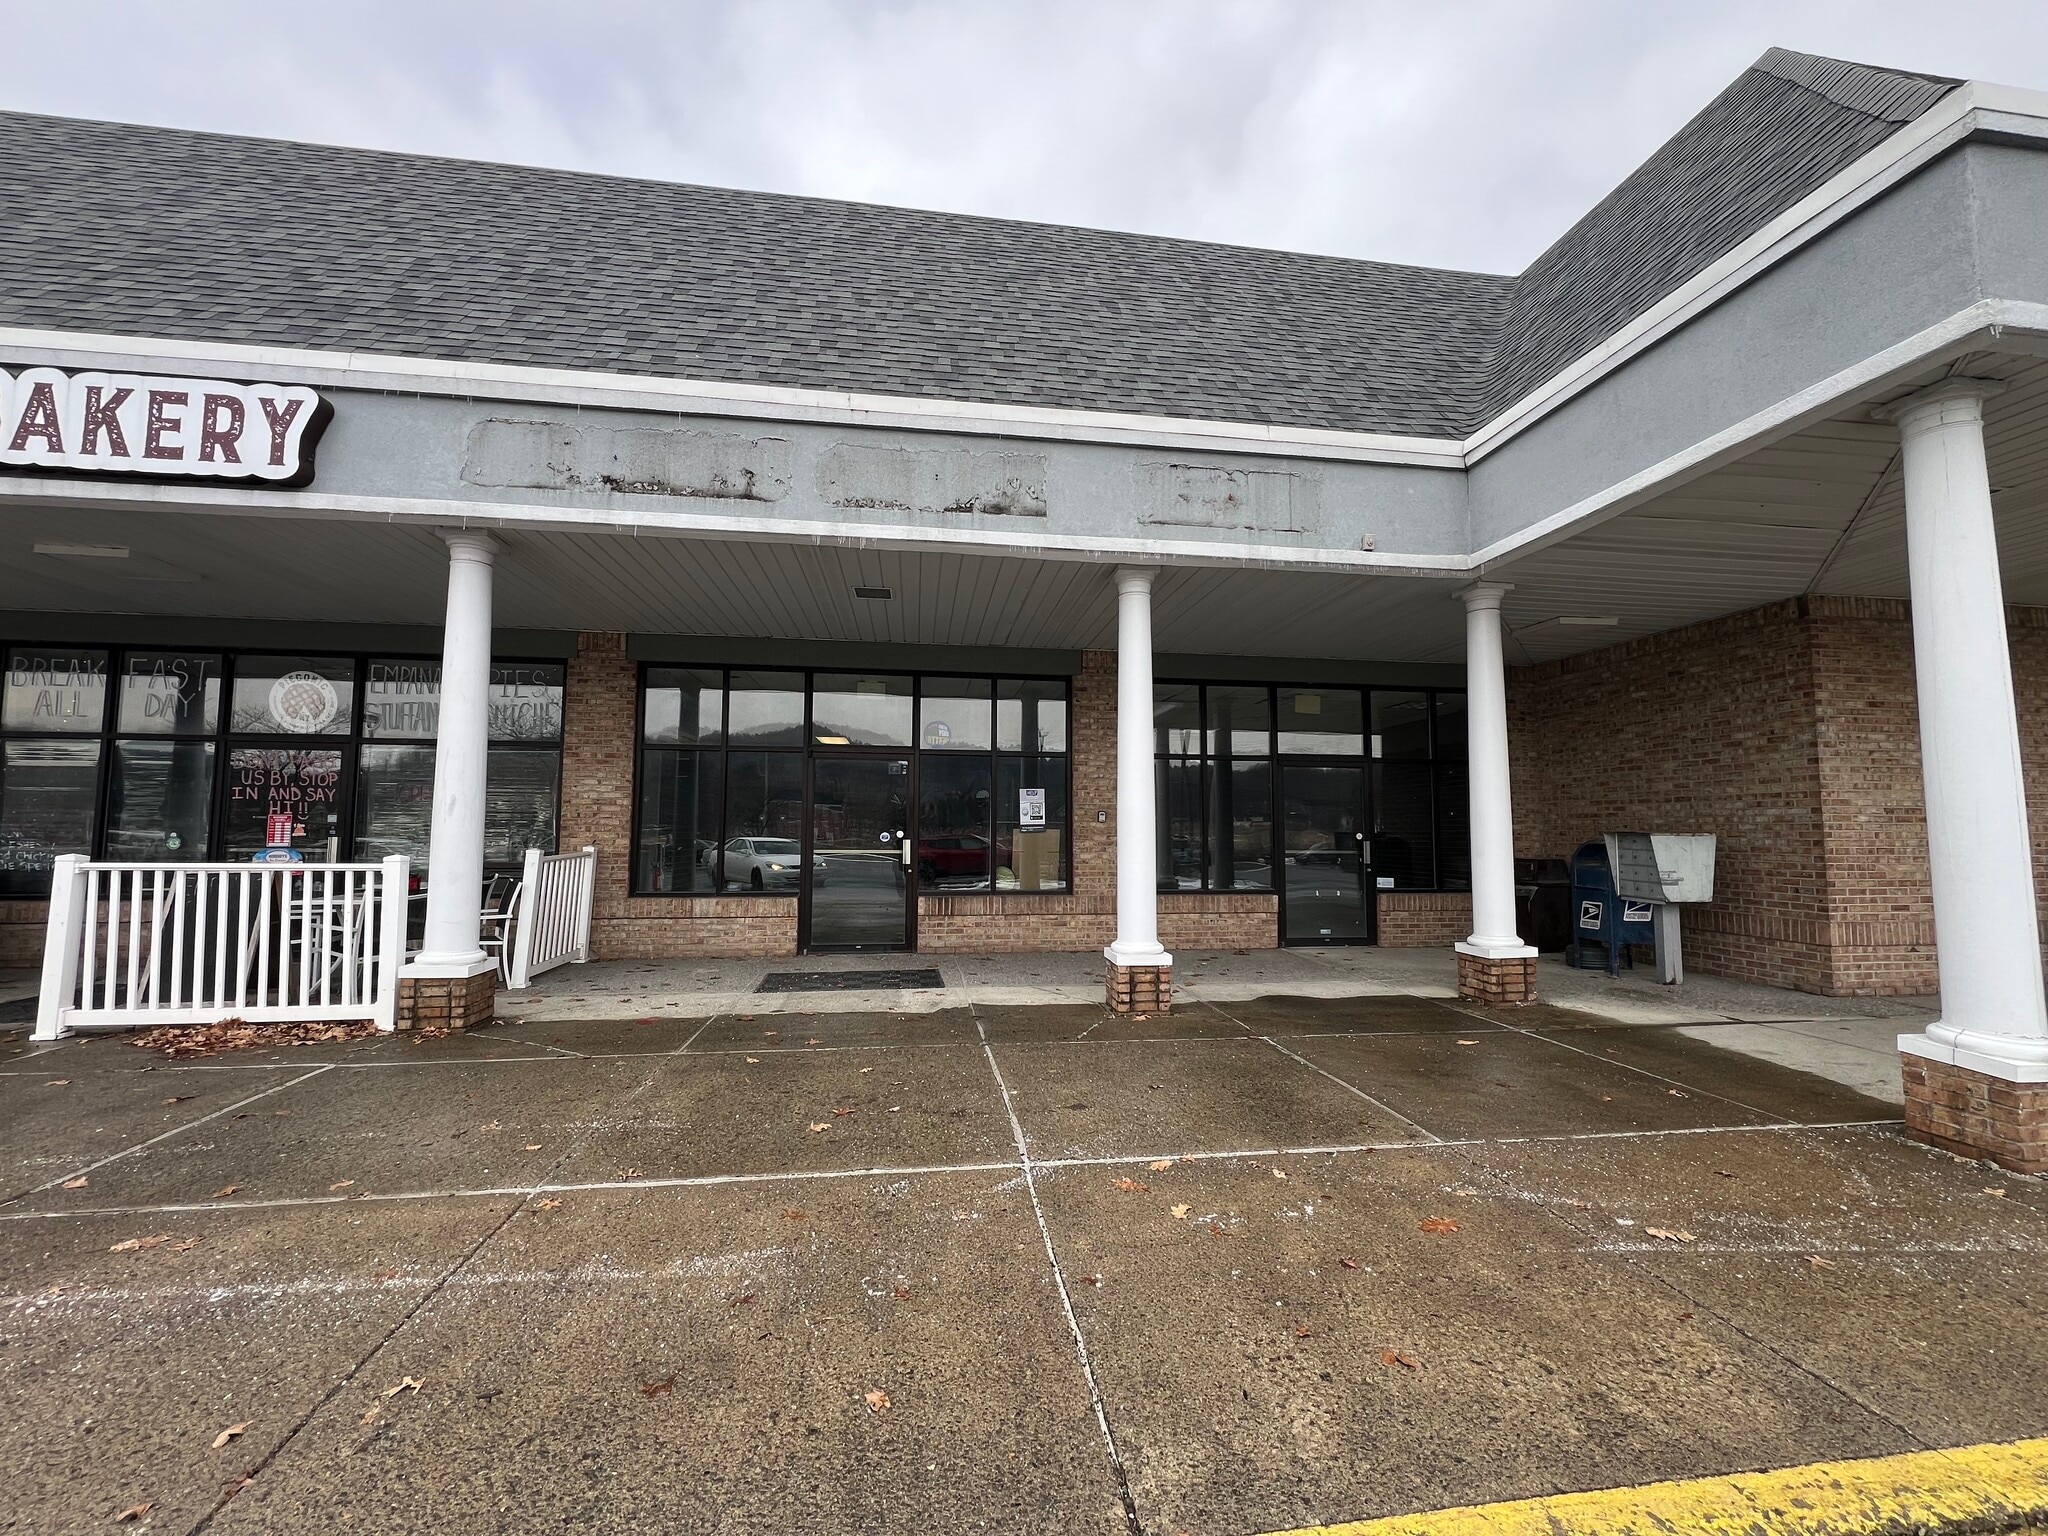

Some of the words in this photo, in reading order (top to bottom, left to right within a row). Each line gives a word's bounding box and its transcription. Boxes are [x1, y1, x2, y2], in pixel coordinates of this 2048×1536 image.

[0, 381, 305, 466] AKERY
[11, 656, 105, 688] BREAK
[128, 658, 215, 692] FAST
[370, 663, 442, 694] EMPANA
[32, 690, 89, 718] ALL
[144, 692, 196, 718] DAY
[241, 770, 265, 785] US
[299, 771, 339, 786] STOP
[232, 787, 258, 800] IN
[268, 787, 301, 801] AND
[305, 788, 336, 802] SAY
